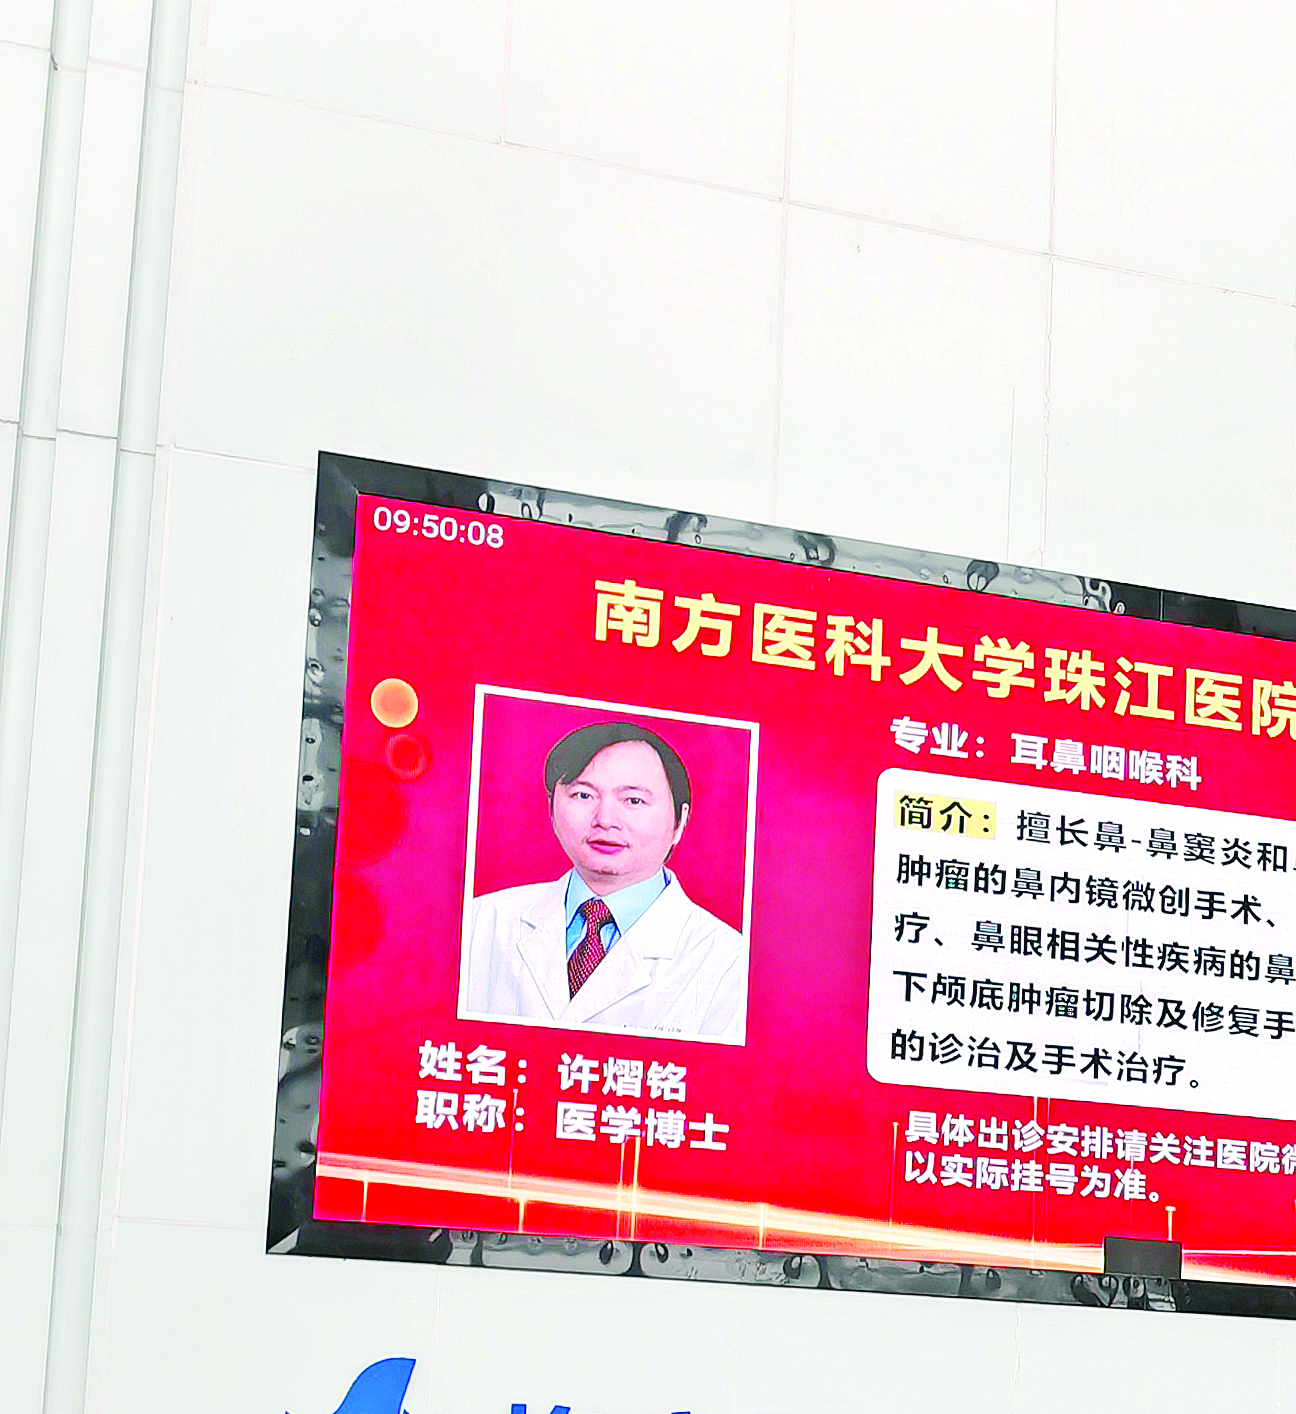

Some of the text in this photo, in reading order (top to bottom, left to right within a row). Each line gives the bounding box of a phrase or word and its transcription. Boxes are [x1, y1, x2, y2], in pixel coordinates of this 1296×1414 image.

[373, 506, 504, 548] 09:50:08
[890, 1029, 1202, 1090] 的诊治及手术治疗。
[904, 1151, 1162, 1203] 以实际挂号为准。
